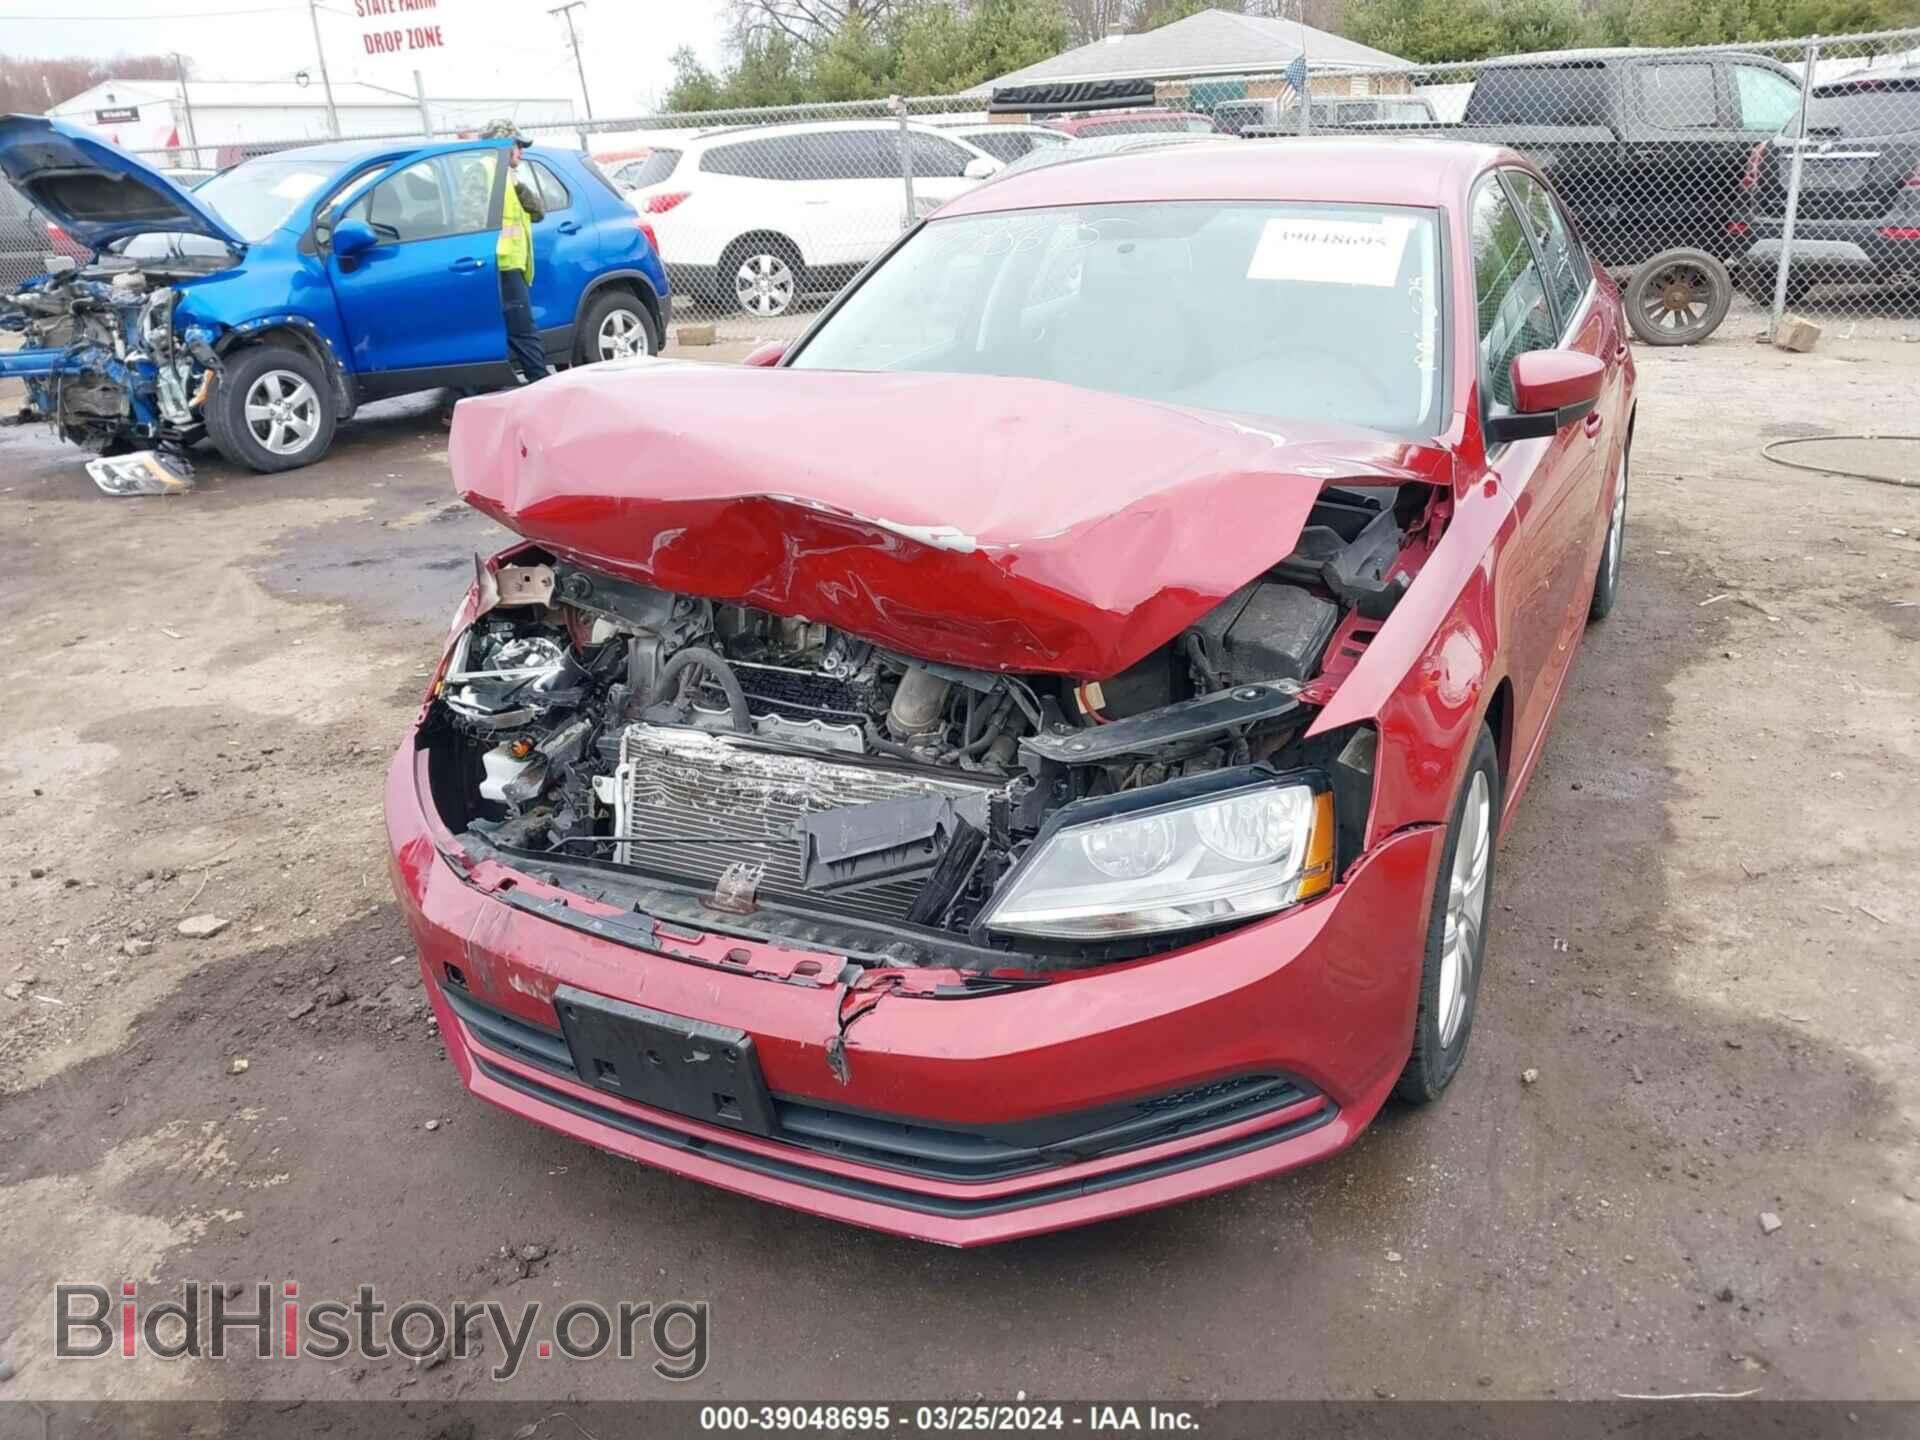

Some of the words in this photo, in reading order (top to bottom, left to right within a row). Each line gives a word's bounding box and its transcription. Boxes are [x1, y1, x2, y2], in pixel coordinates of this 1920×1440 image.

[354, 0, 396, 17] STATE
[363, 30, 403, 55] DROP
[406, 25, 445, 50] ZONE
